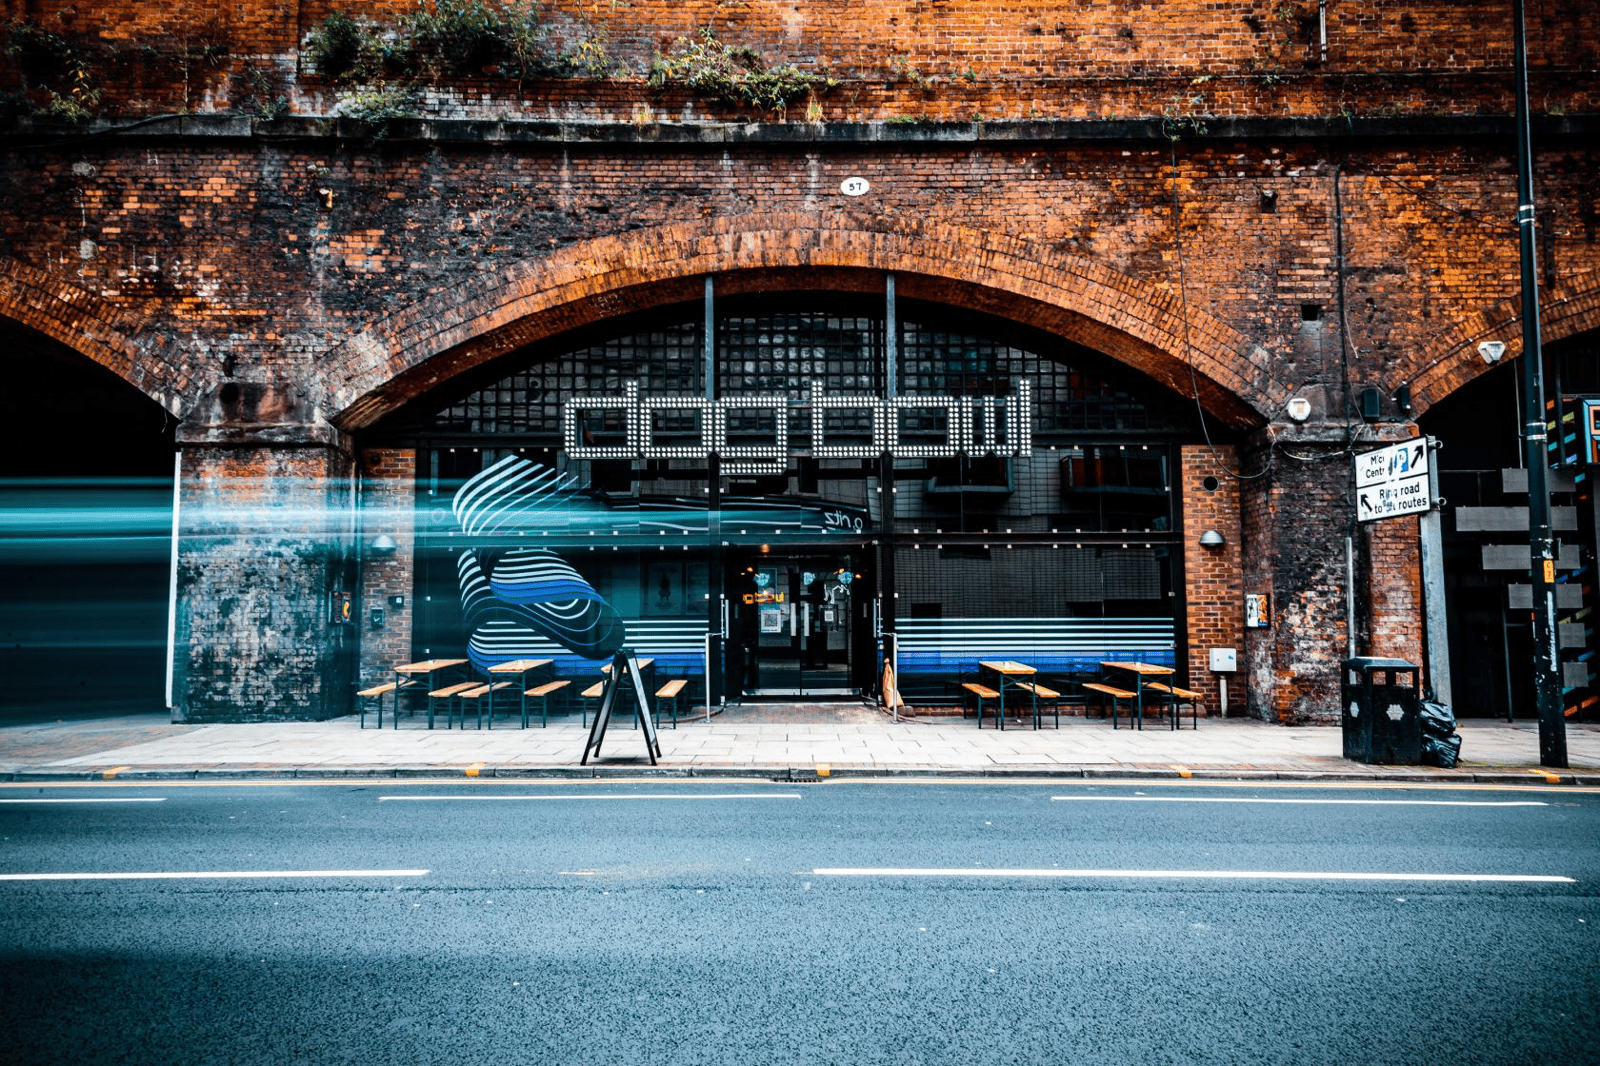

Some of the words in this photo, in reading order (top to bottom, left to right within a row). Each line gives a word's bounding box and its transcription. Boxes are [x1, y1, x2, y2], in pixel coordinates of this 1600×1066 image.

[849, 182, 862, 191] 57
[563, 379, 788, 475] dog
[811, 378, 1032, 458] bowl
[1401, 482, 1419, 495] road
[1374, 504, 1383, 514] to
[1399, 497, 1426, 509] routes
